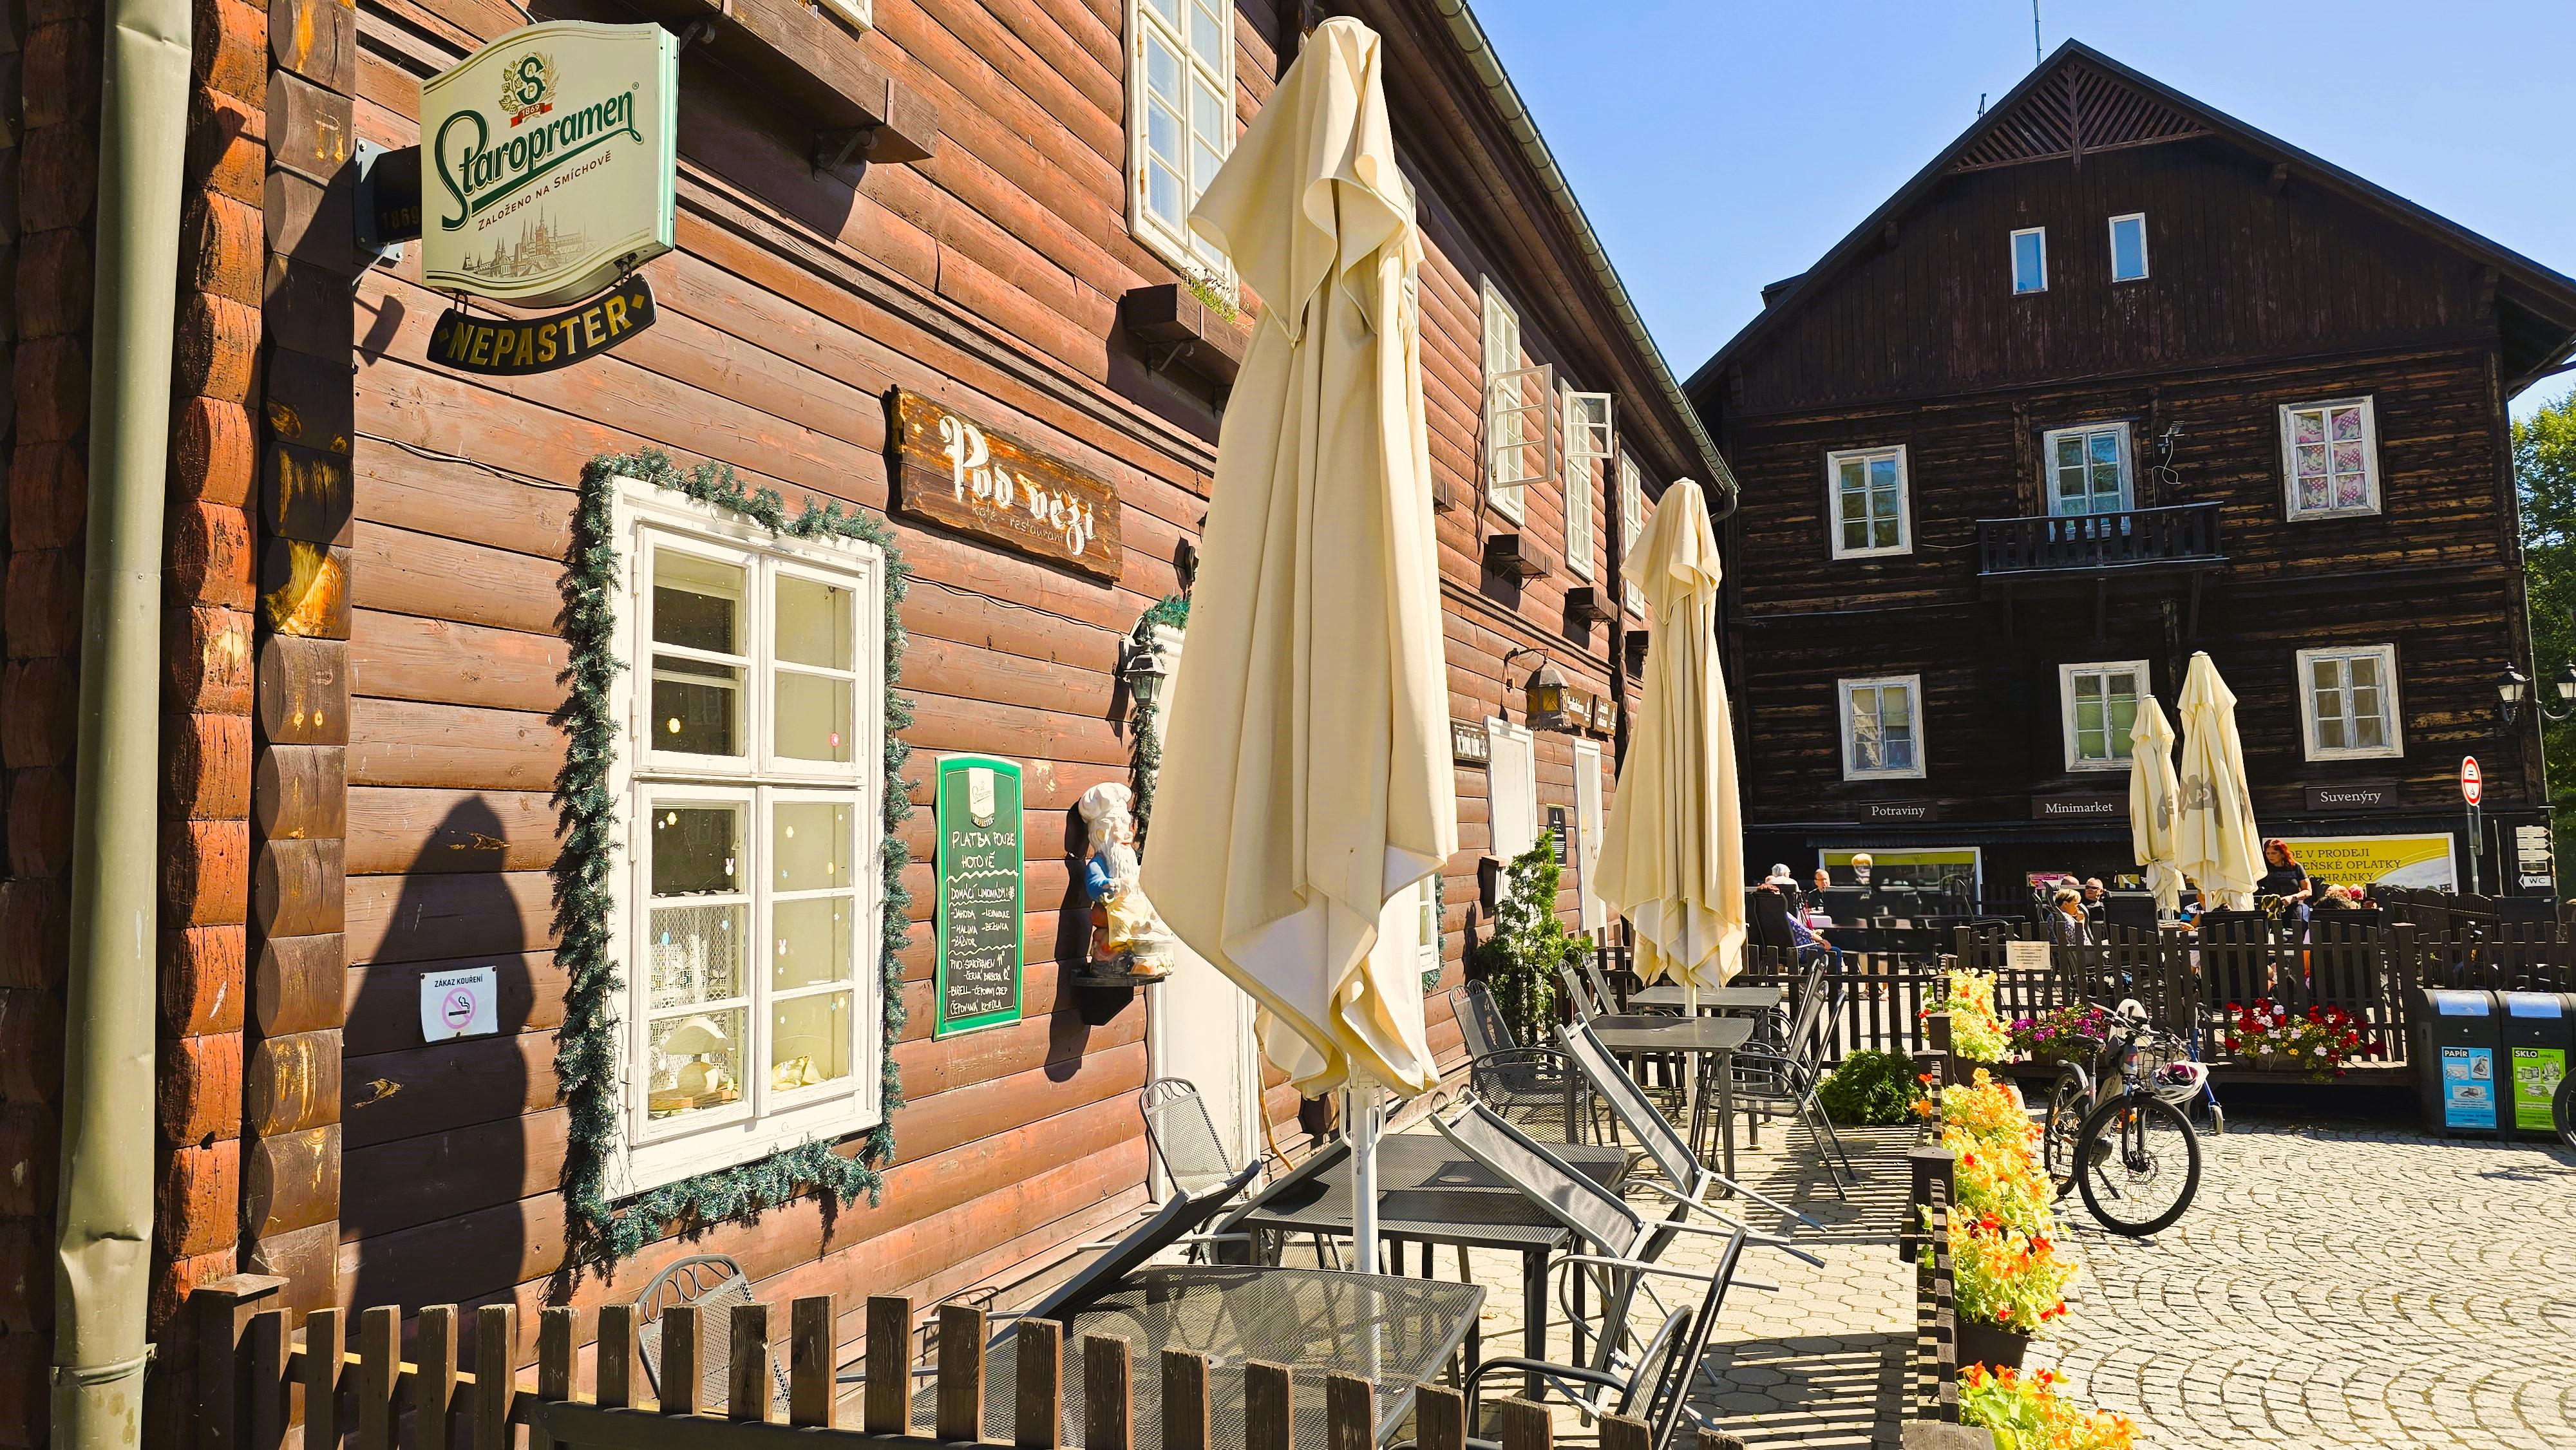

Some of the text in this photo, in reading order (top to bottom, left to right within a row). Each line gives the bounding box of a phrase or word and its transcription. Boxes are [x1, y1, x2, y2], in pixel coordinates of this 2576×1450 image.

[521, 104, 540, 117] 1869
[434, 90, 644, 231] Staropramen
[478, 150, 612, 231] ZALOŽENO NA SMÍCHOVĚ
[447, 295, 633, 367] NEPASTER
[939, 415, 1014, 509] Pod
[1010, 518, 1063, 543] restaurant
[2320, 790, 2382, 804] Suvenýry
[1871, 805, 1926, 818] Potraviny
[2045, 801, 2113, 813] Minimarket
[952, 831, 1016, 849] PLATBA POUZE
[961, 850, 996, 869] HOTOVĚ
[2306, 850, 2314, 858] V
[2318, 848, 2370, 858] PRODEJI
[2301, 859, 2401, 870] EŇSKÉ OPLATKY
[951, 883, 978, 900] DOMÁCÍ
[434, 973, 483, 988] ZÁKAZ KOUŘENÍ
